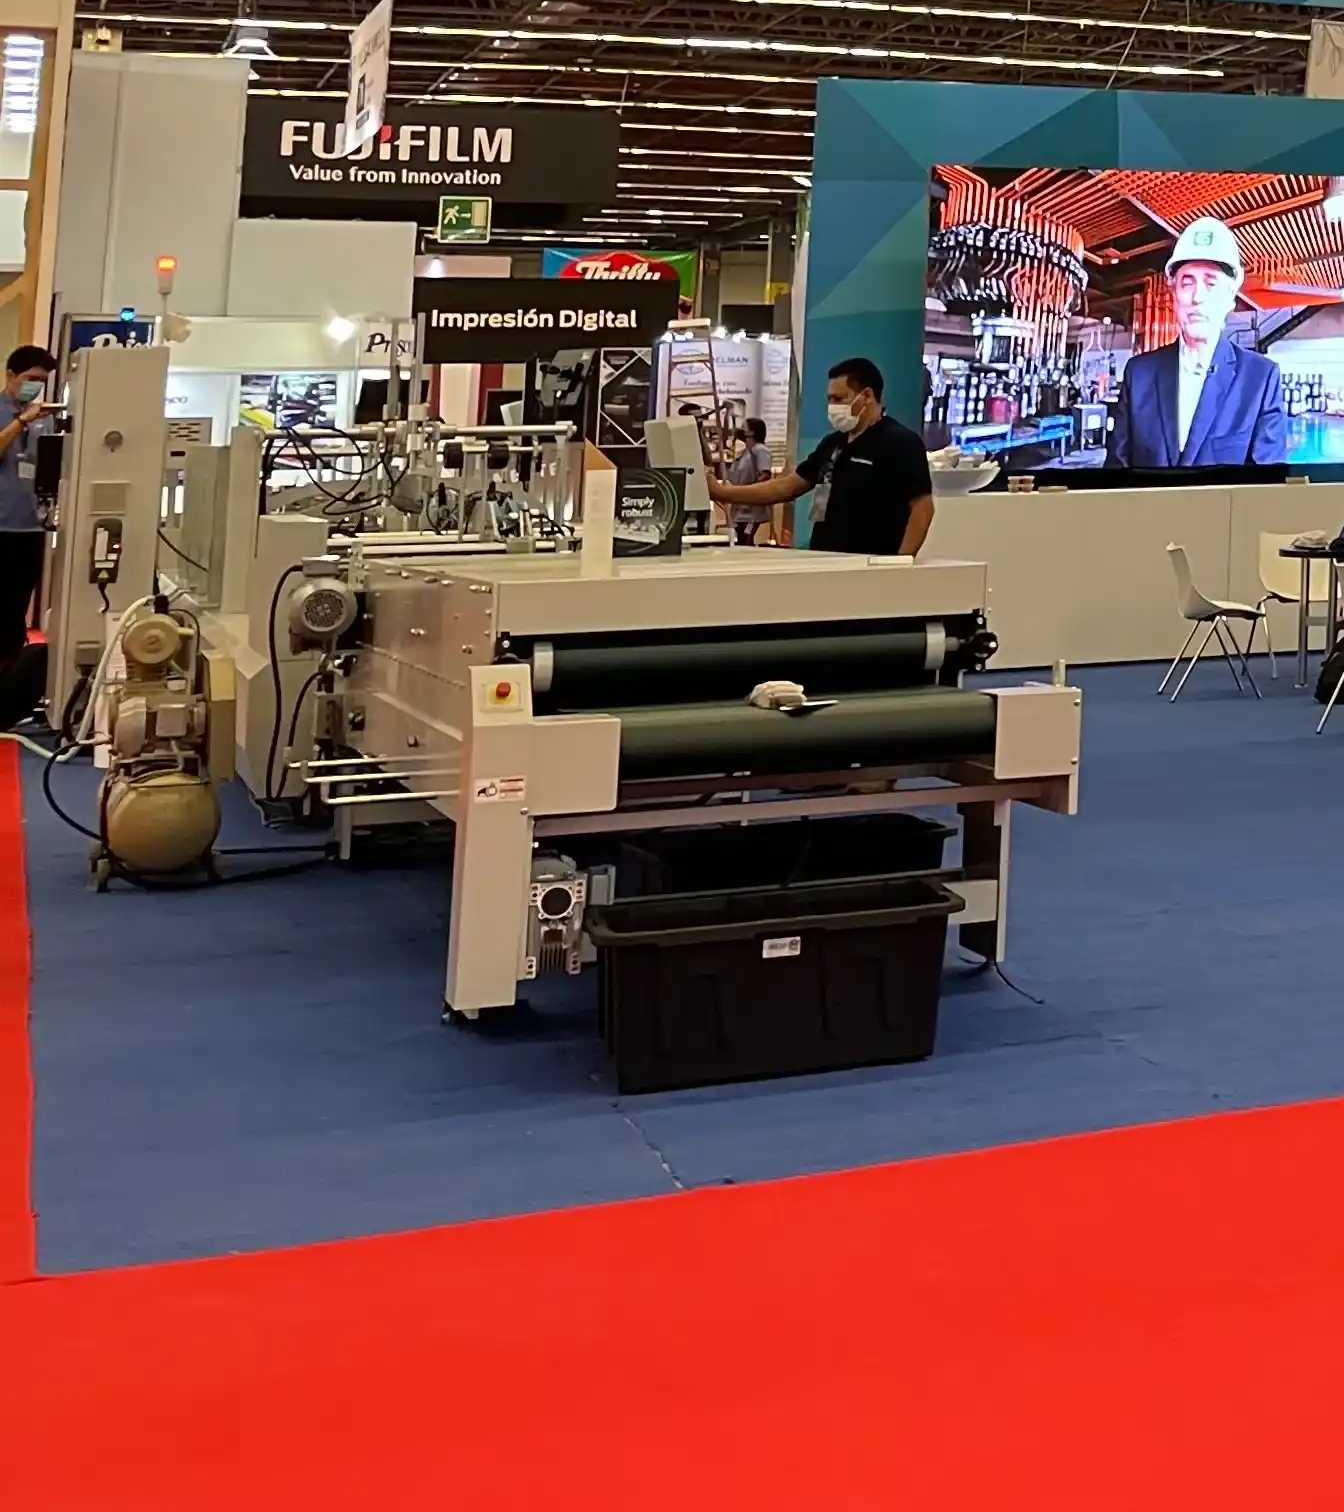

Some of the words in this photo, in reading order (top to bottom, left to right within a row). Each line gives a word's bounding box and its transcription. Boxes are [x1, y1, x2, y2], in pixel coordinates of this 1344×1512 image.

[289, 163, 343, 181] Value
[350, 166, 396, 183] from
[401, 169, 502, 185] Innovation
[431, 308, 554, 331] Impresión
[559, 308, 637, 331] Digital
[621, 495, 656, 508] Simply
[621, 506, 654, 518] robust
